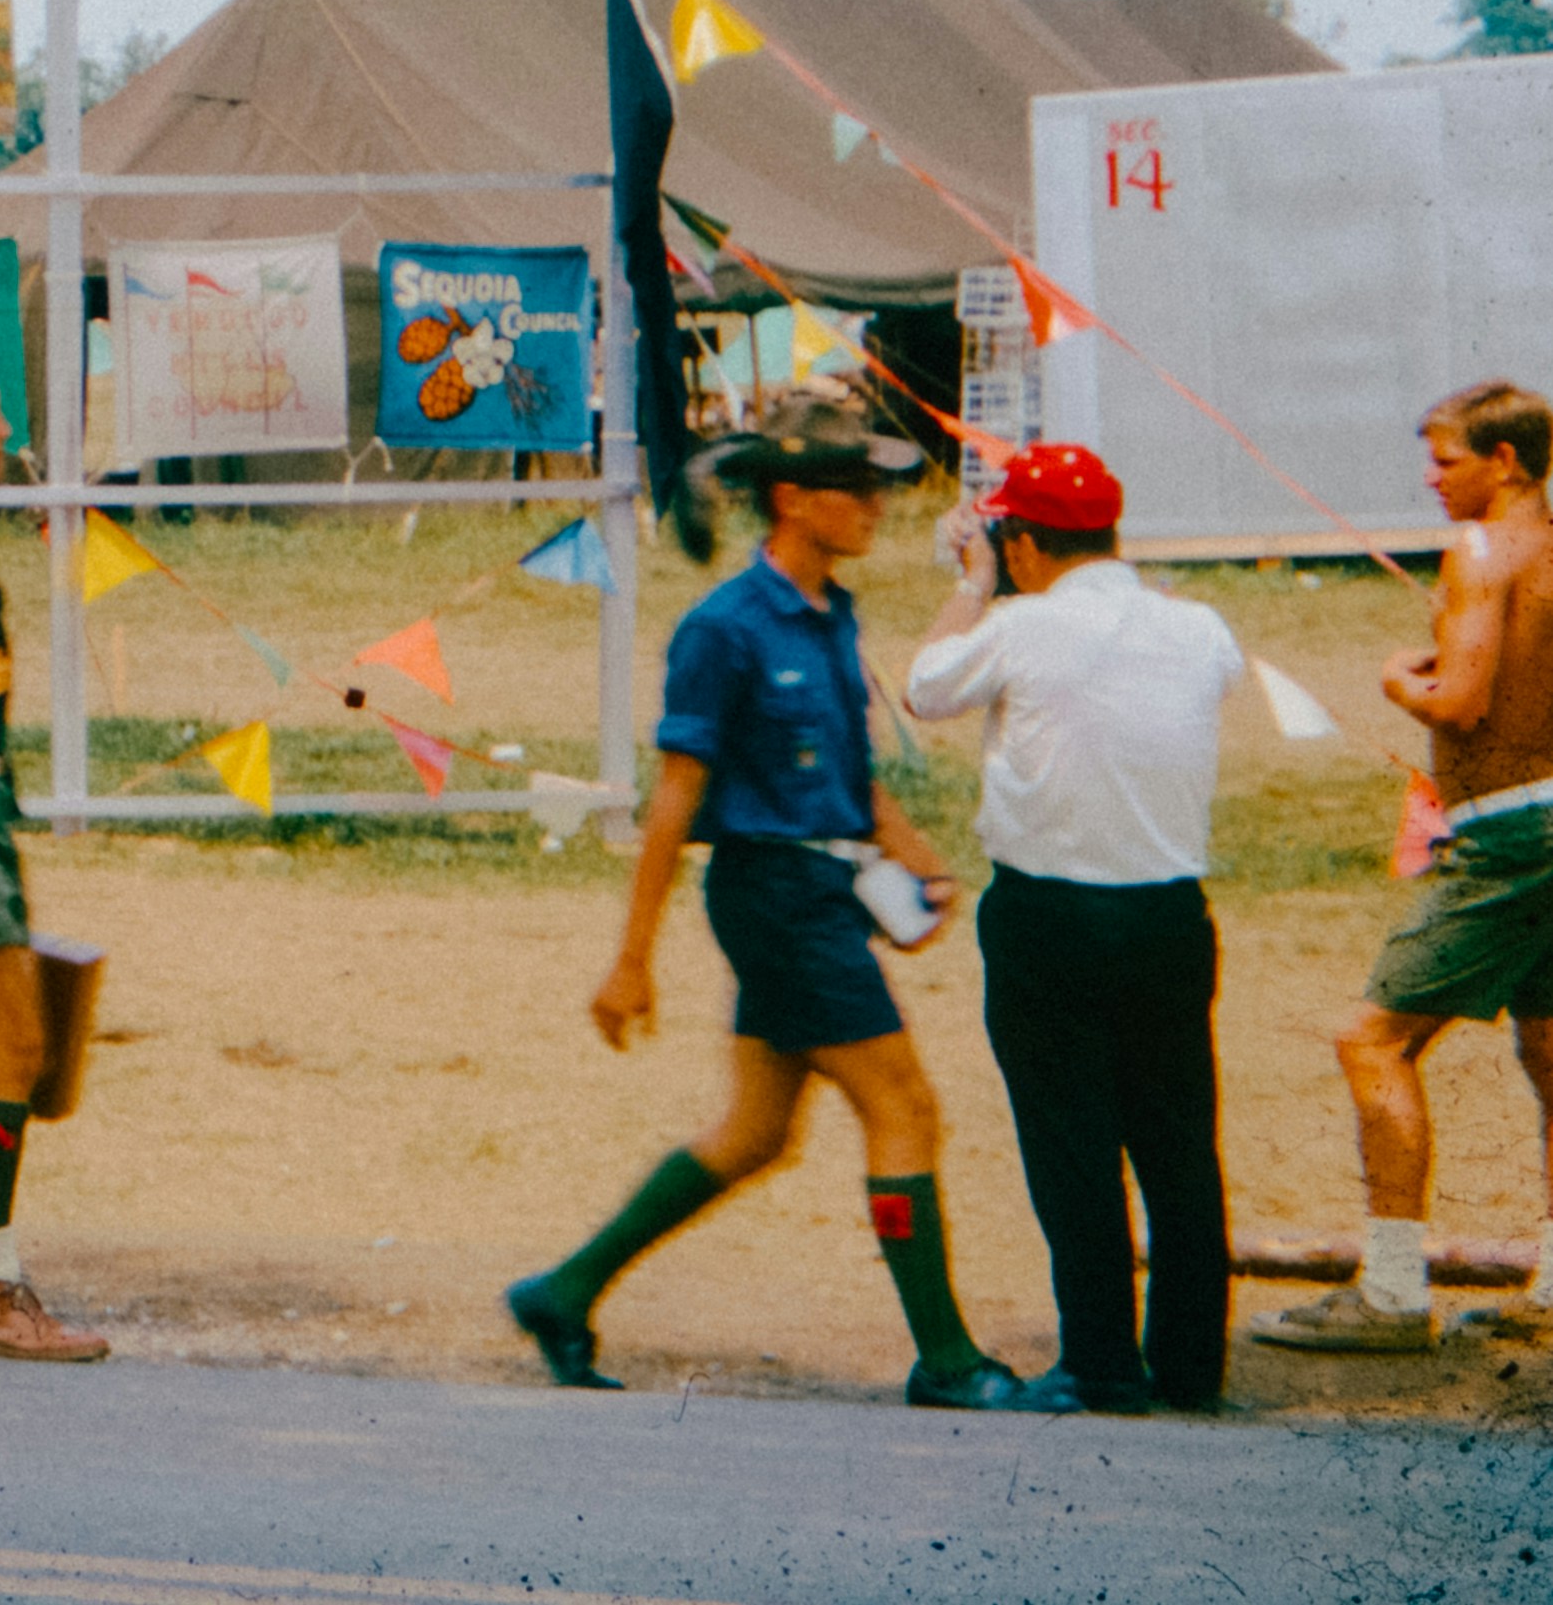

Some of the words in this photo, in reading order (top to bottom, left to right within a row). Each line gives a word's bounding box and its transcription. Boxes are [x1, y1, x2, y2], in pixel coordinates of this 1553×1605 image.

[1105, 148, 1178, 214] 14
[393, 259, 523, 308] SEQUOIA
[500, 303, 583, 339] COUNCIL
